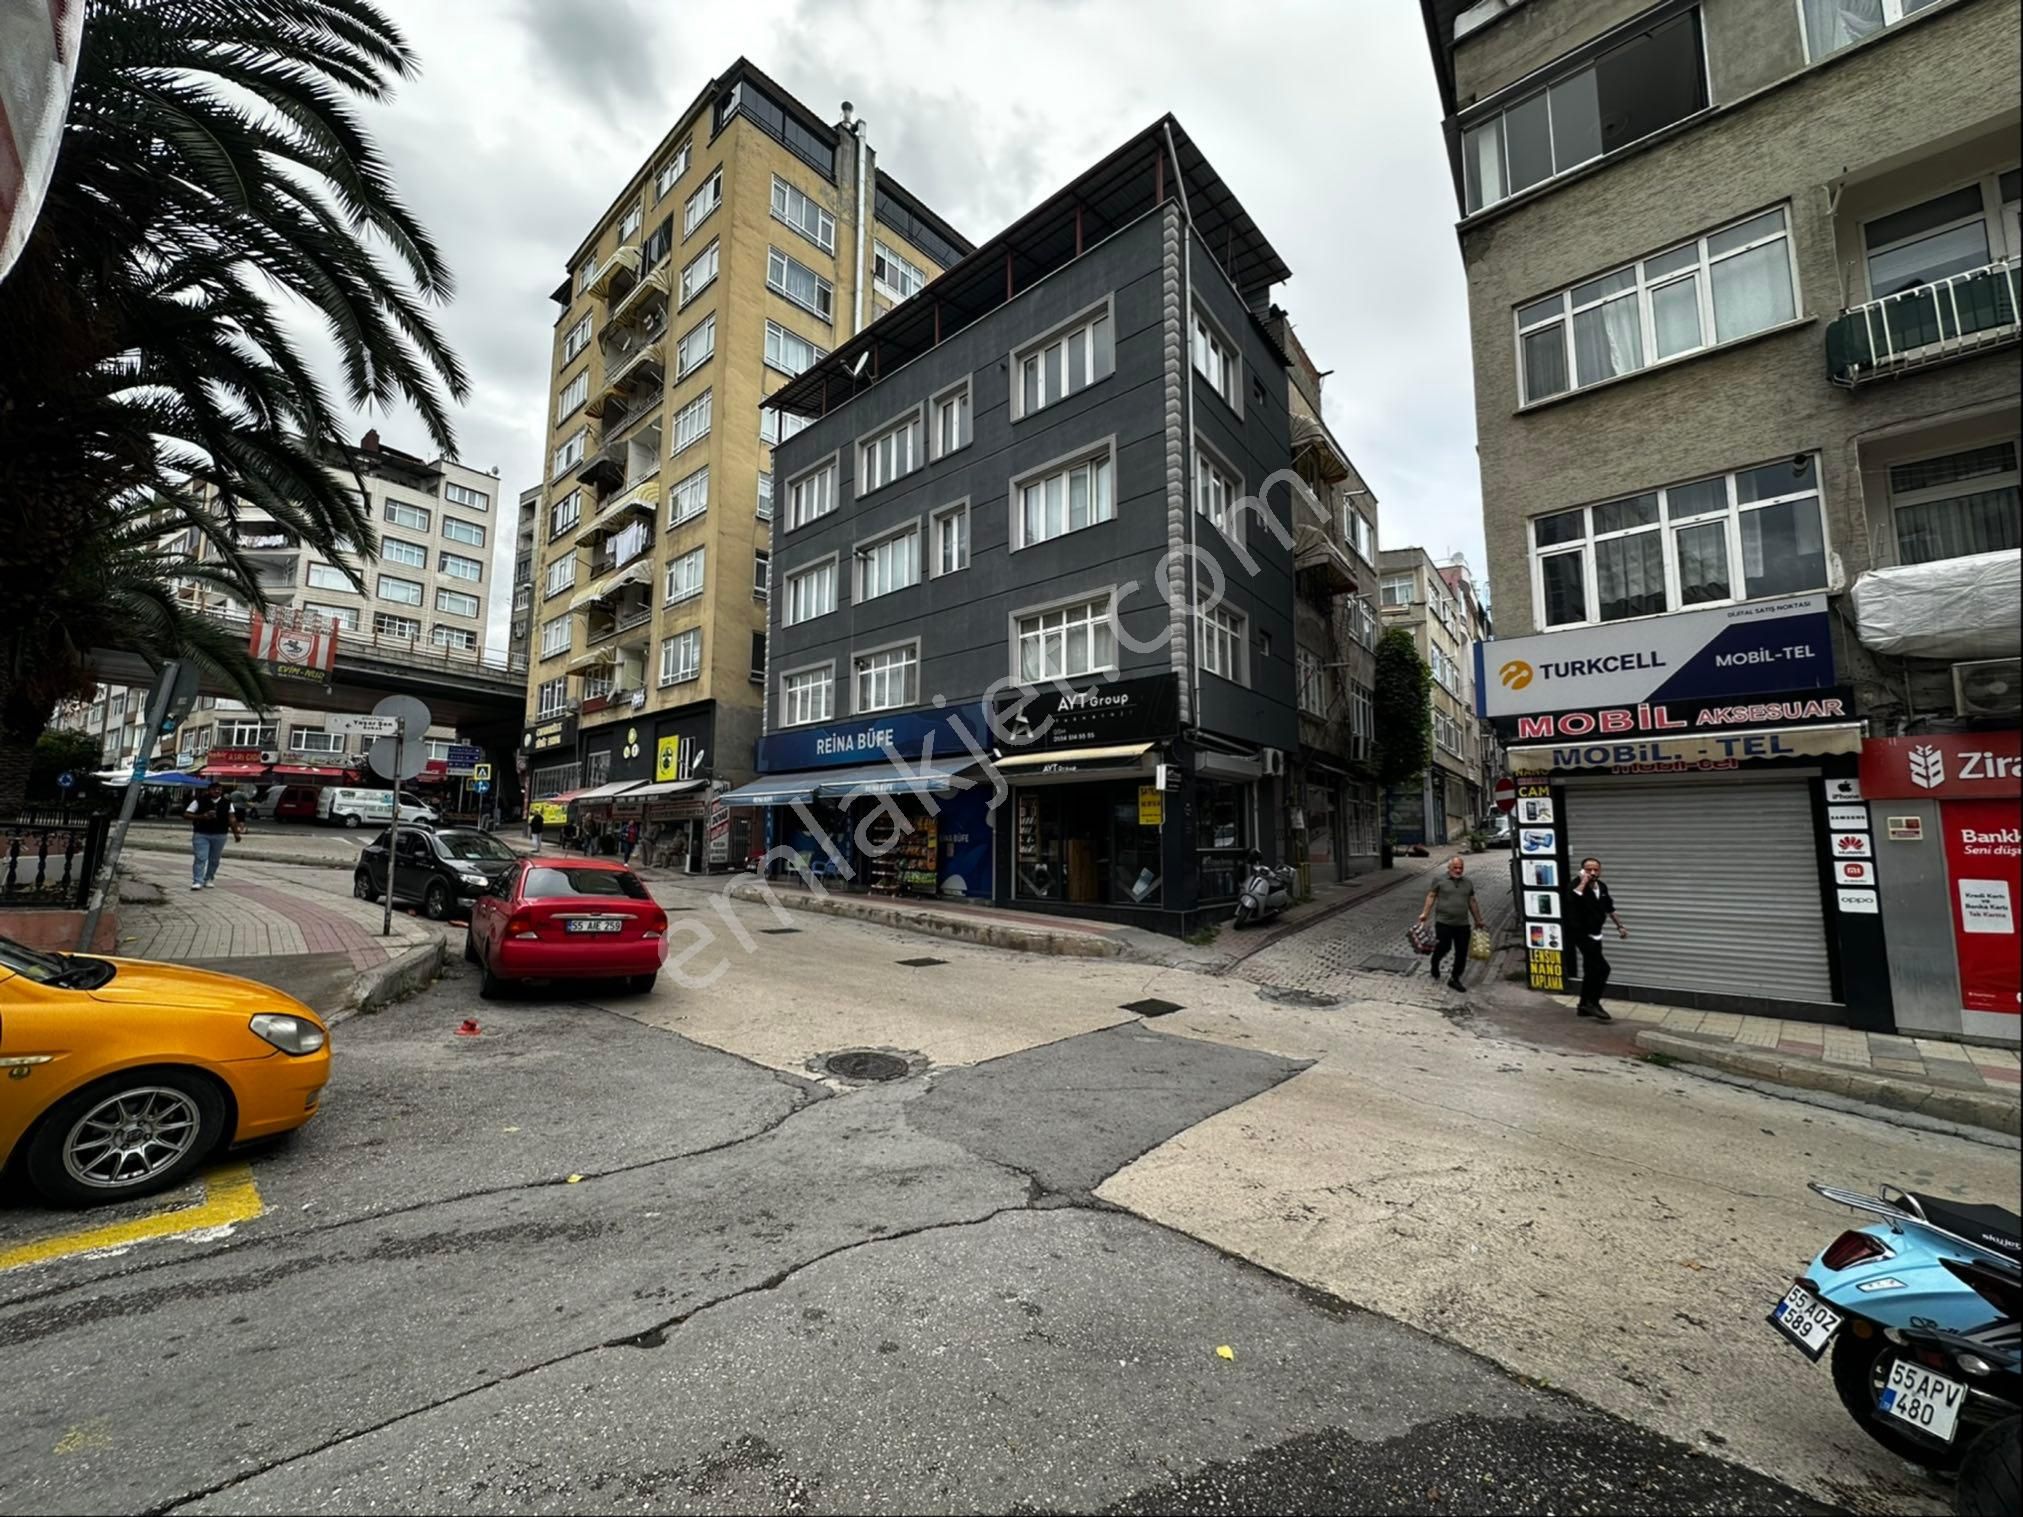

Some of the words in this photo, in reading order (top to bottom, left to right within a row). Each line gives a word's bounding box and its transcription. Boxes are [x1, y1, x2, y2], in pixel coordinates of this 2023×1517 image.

[1539, 651, 1666, 680] TURKCELL
[1715, 645, 1815, 667] MOBİL-TEL
[1058, 692, 1088, 711] AYT
[1089, 694, 1129, 707] Group
[1518, 703, 1687, 738] MOBİL
[1696, 699, 1845, 726] AKSESUAR
[816, 733, 854, 755] REİNA
[857, 728, 894, 749] BÜFE
[1716, 735, 1794, 756] TEL
[1518, 786, 1550, 797] CAM
[1964, 845, 1991, 855] Seni
[572, 921, 583, 929] 55
[604, 921, 620, 930] 259
[1530, 961, 1562, 976] NANO
[1531, 974, 1563, 990] KAPLAMA
[1788, 1288, 1809, 1308] 55
[1784, 1308, 1813, 1337] 589
[1892, 1364, 1918, 1389] 55
[1917, 1376, 1960, 1407] APV
[1896, 1393, 1934, 1425] 480
